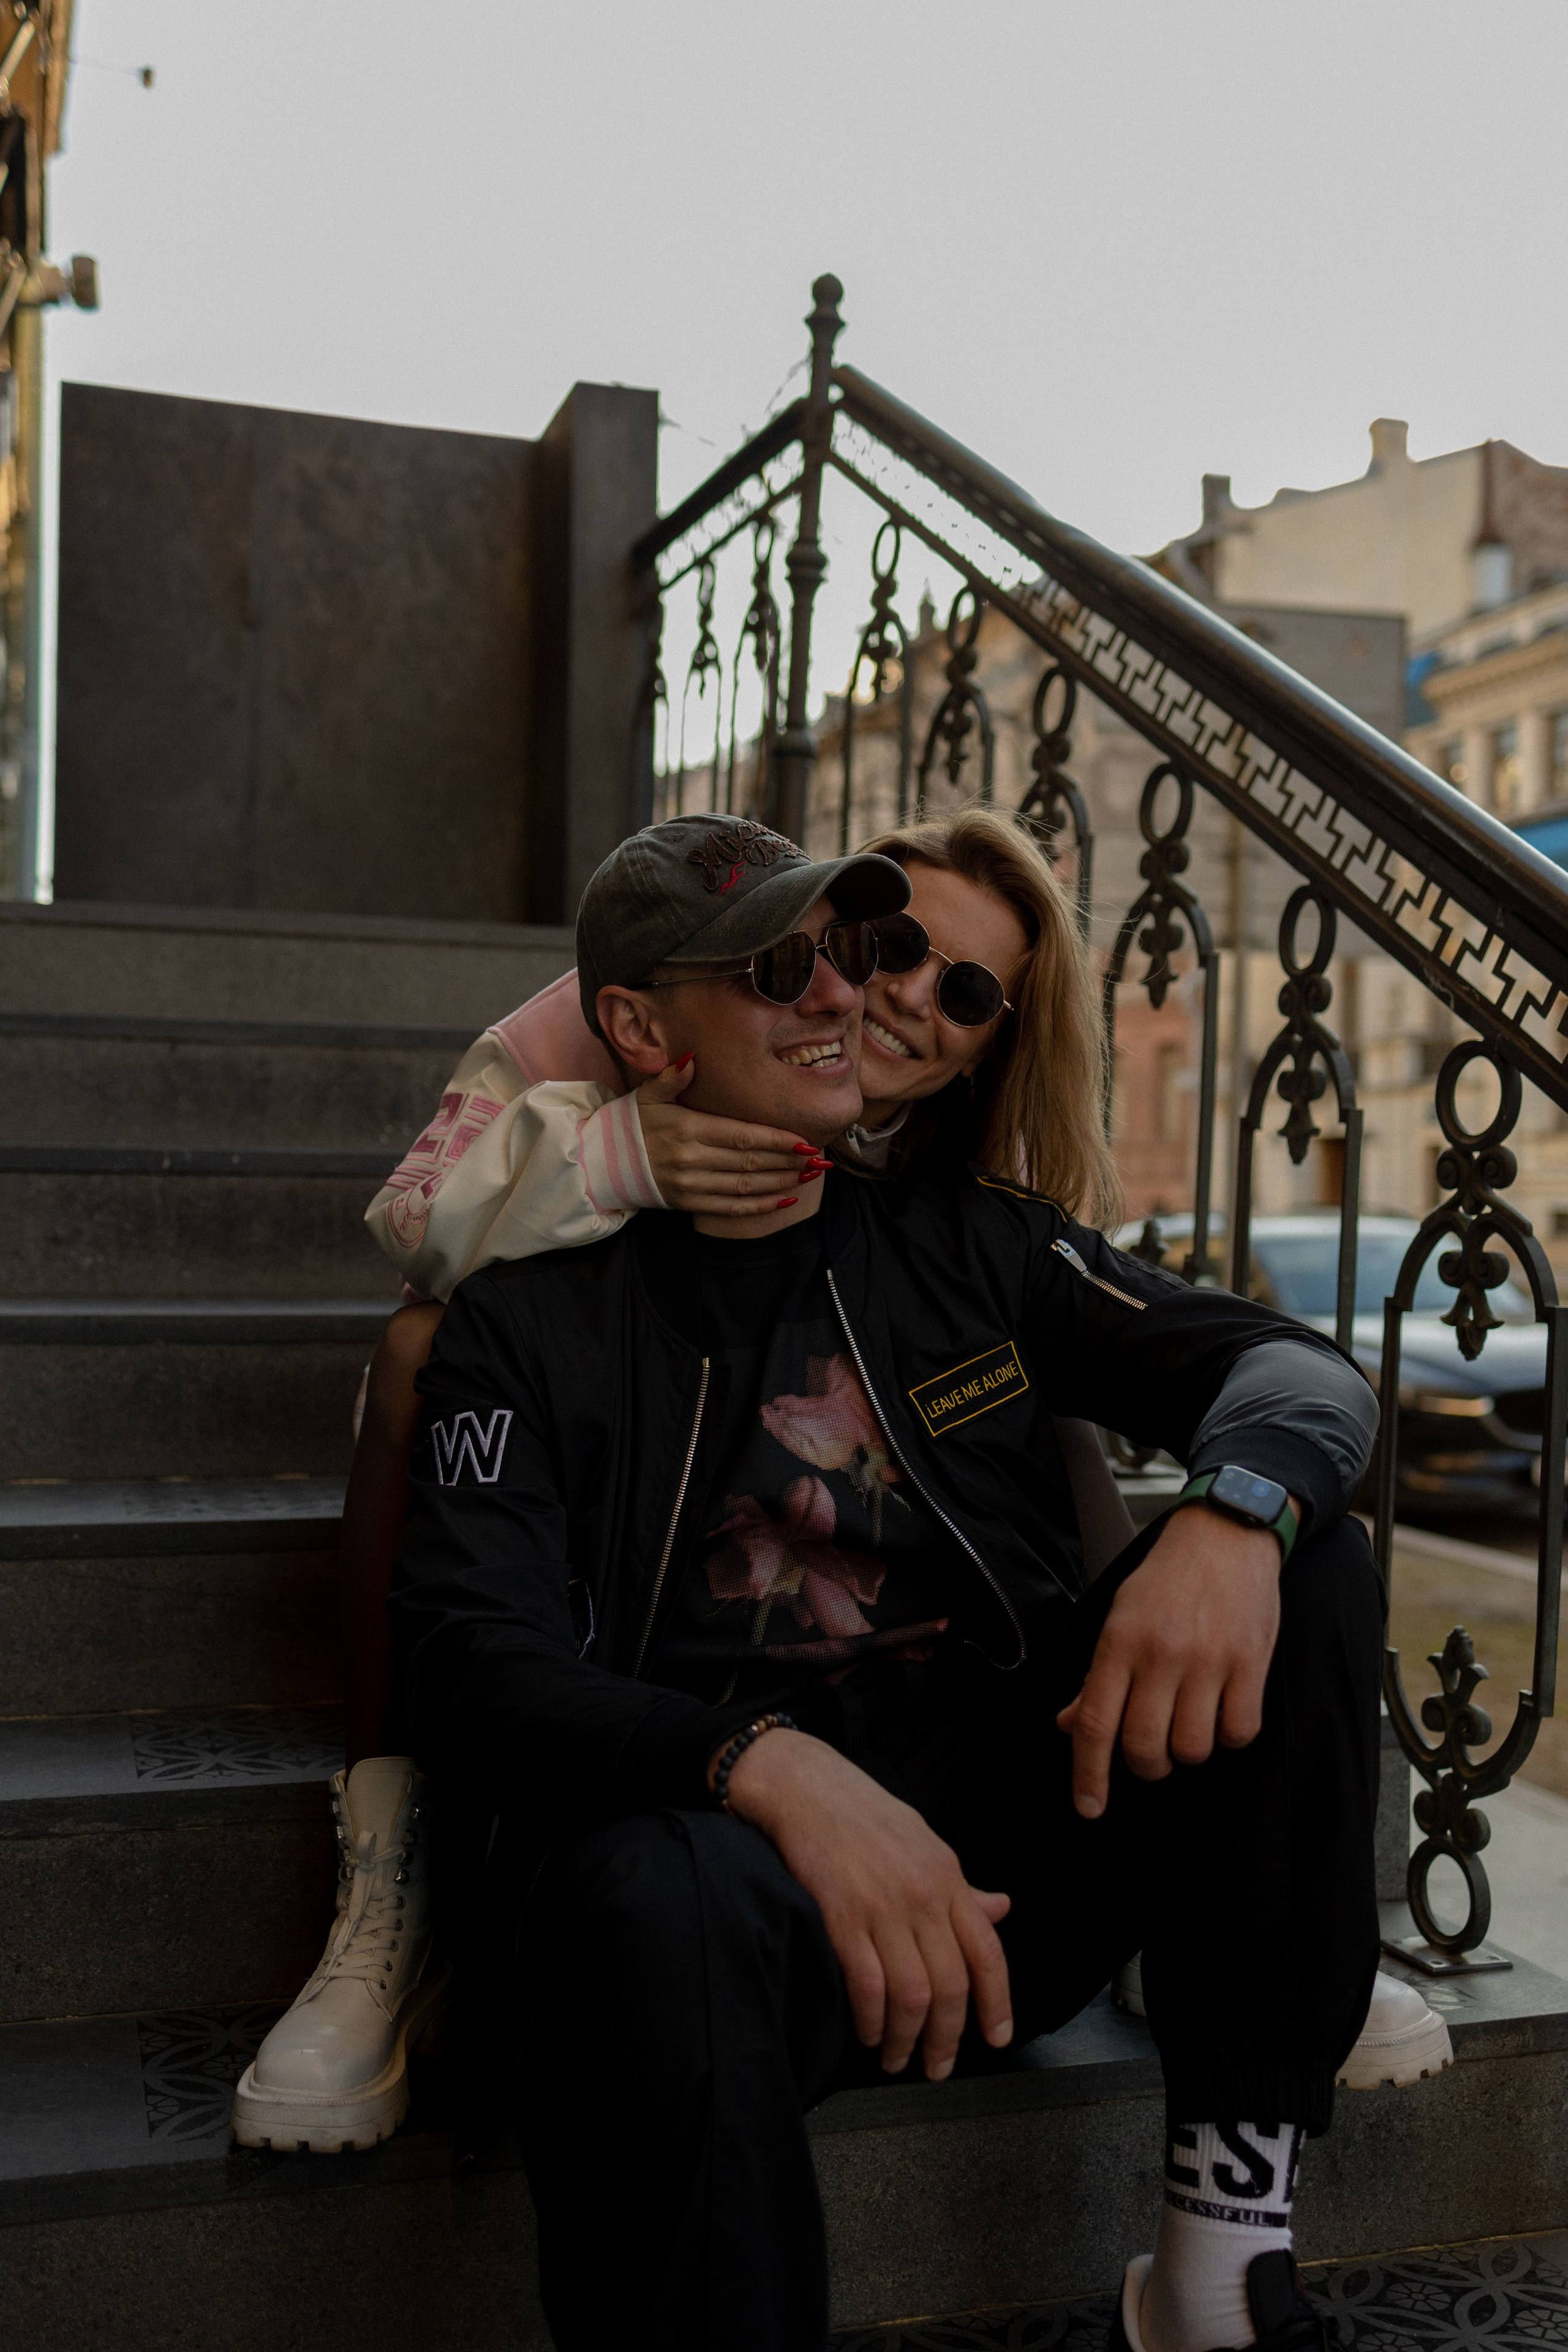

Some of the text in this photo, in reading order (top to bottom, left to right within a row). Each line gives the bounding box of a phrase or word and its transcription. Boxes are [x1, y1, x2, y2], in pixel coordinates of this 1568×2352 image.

[960, 1379, 984, 1401] ME
[982, 1360, 1019, 1392] ALONE
[431, 1409, 514, 1487] W
